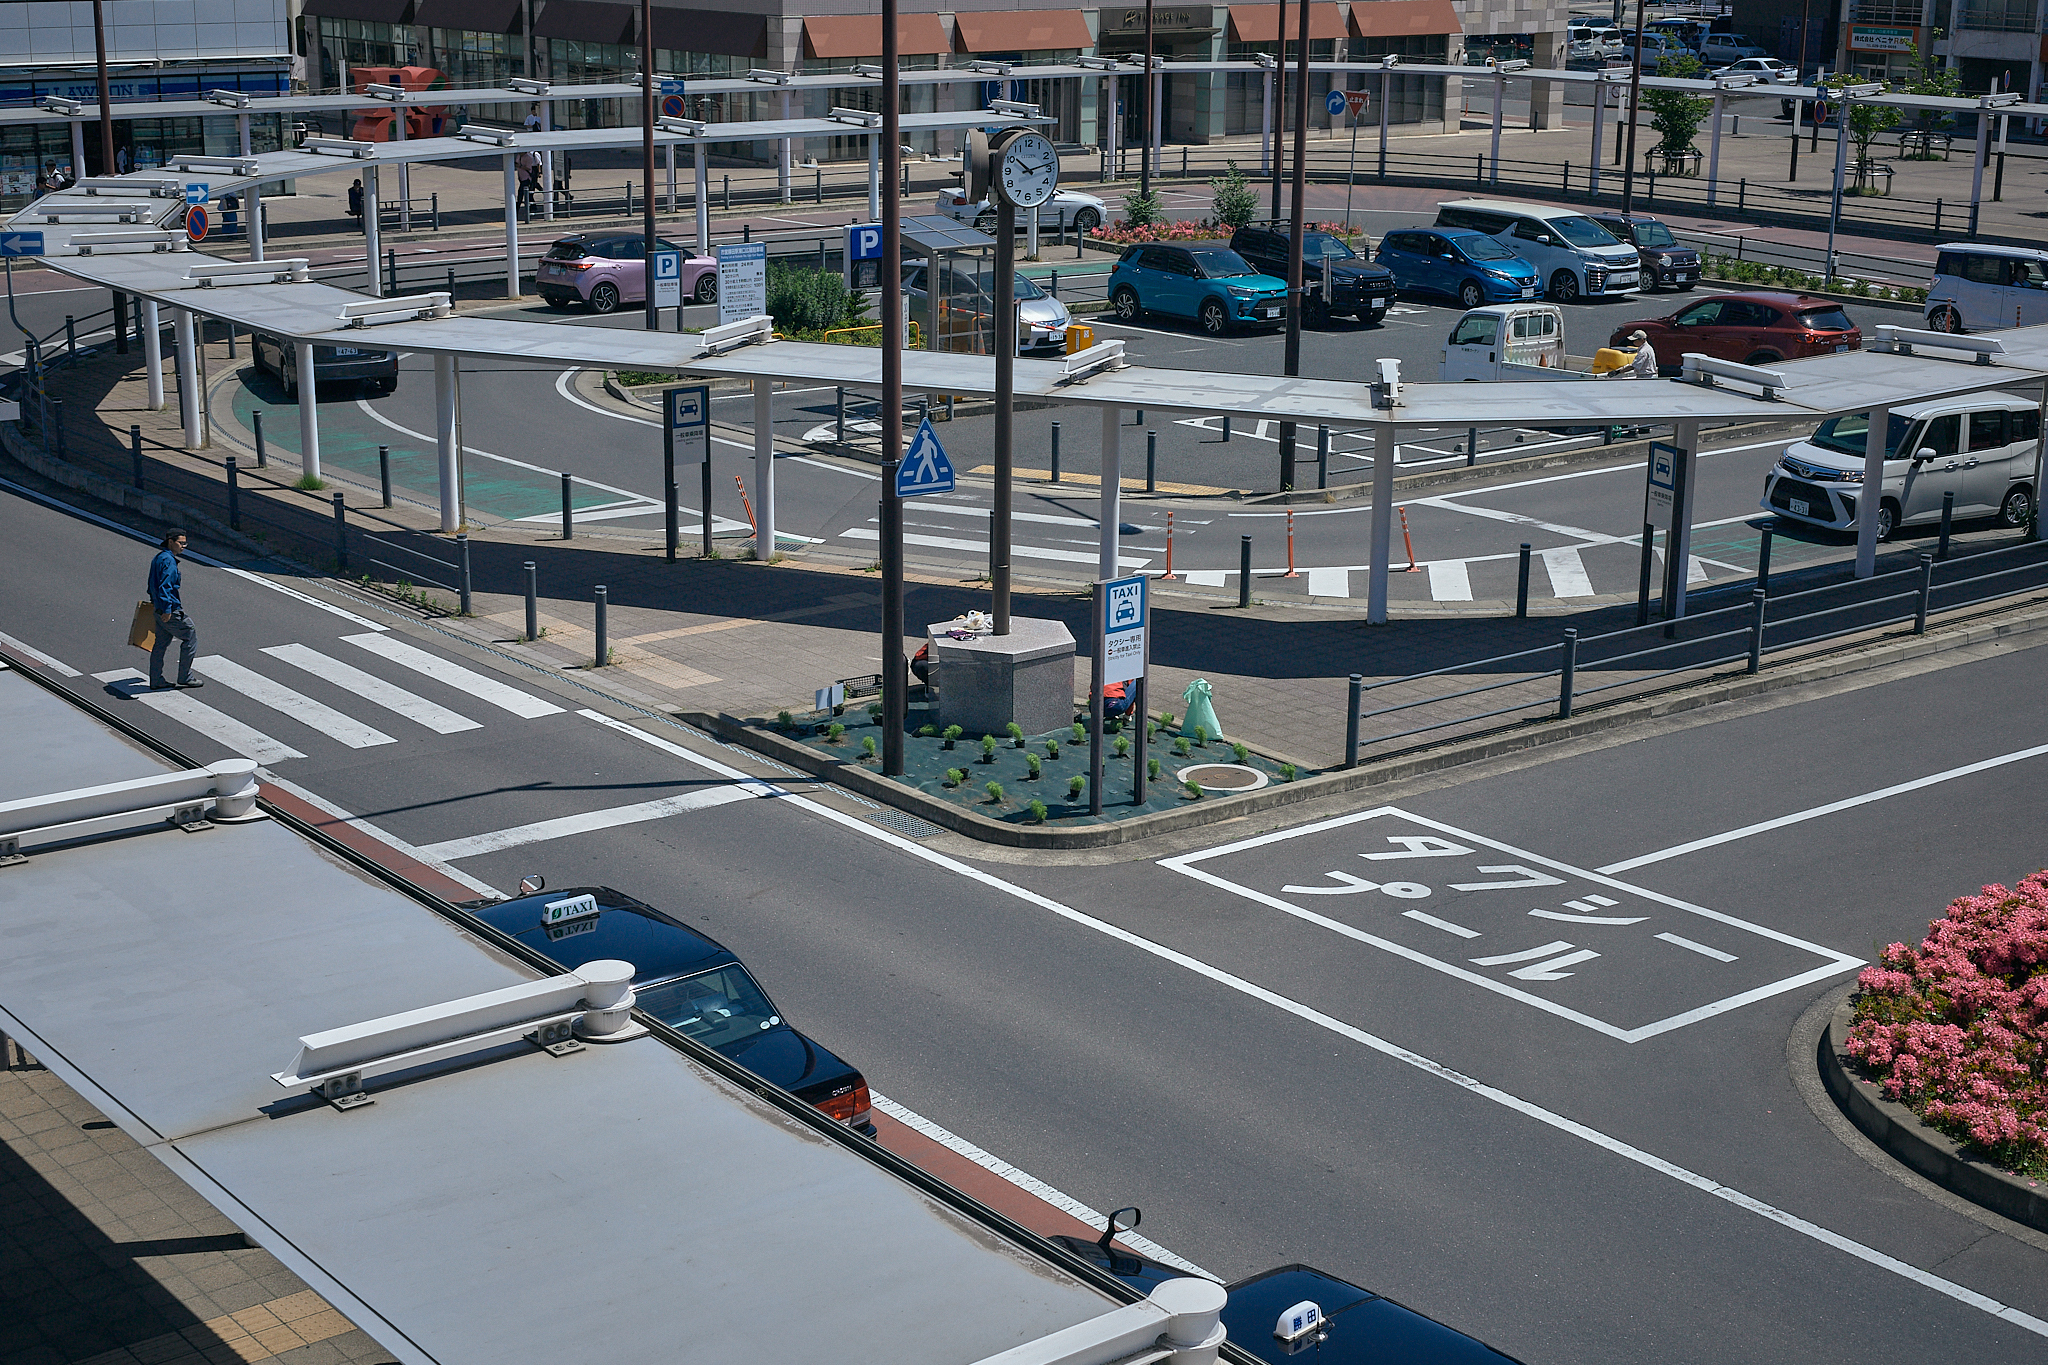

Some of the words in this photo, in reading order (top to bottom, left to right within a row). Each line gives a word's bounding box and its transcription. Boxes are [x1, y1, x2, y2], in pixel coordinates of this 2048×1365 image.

[53, 84, 134, 98] LAWON
[1014, 145, 1021, 153] 11
[1037, 142, 1041, 150] 1
[1043, 152, 1049, 160] 2
[1046, 164, 1051, 173] 3
[1036, 188, 1042, 196] 5
[861, 229, 879, 257] P
[662, 258, 673, 274] P
[1113, 586, 1138, 599] TAXI
[1108, 634, 1142, 648] タクシー専用
[1358, 835, 1740, 964] タクシー
[564, 901, 593, 916] TAXI
[1280, 870, 1602, 981] プール
